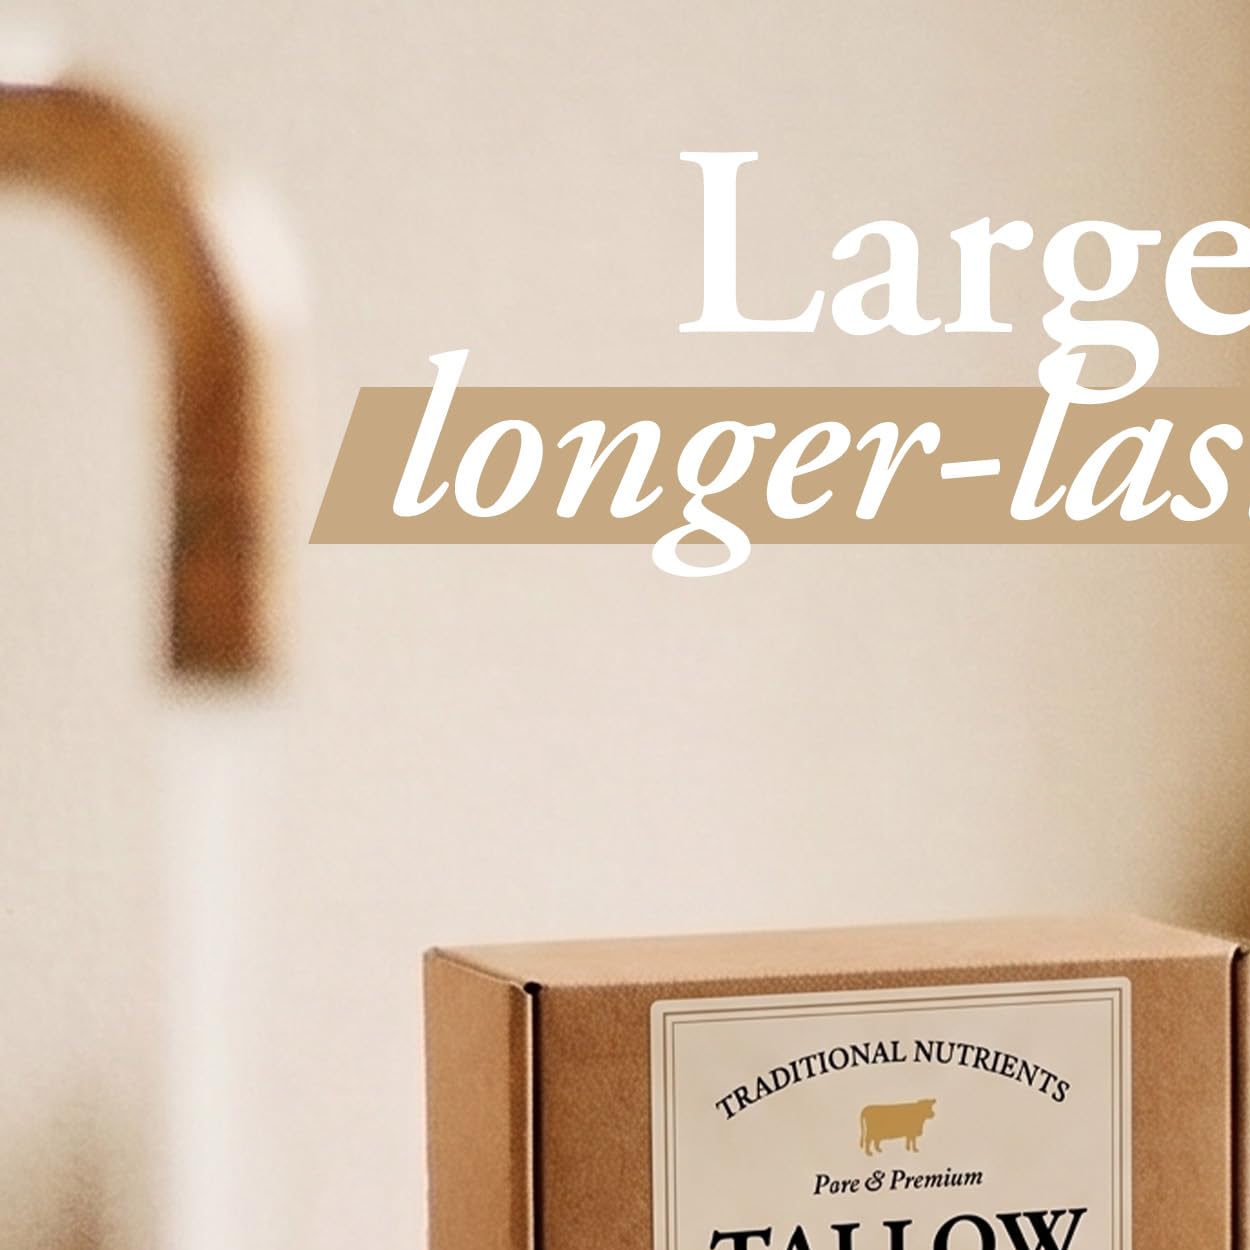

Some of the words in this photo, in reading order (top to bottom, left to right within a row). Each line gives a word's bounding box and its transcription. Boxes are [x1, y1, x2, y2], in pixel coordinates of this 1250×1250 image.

[715, 1040, 907, 1121] TRADITIONAL
[913, 1040, 1071, 1103] NUTRIENTS
[865, 1170, 885, 1192] &
[889, 1167, 984, 1191] Premium
